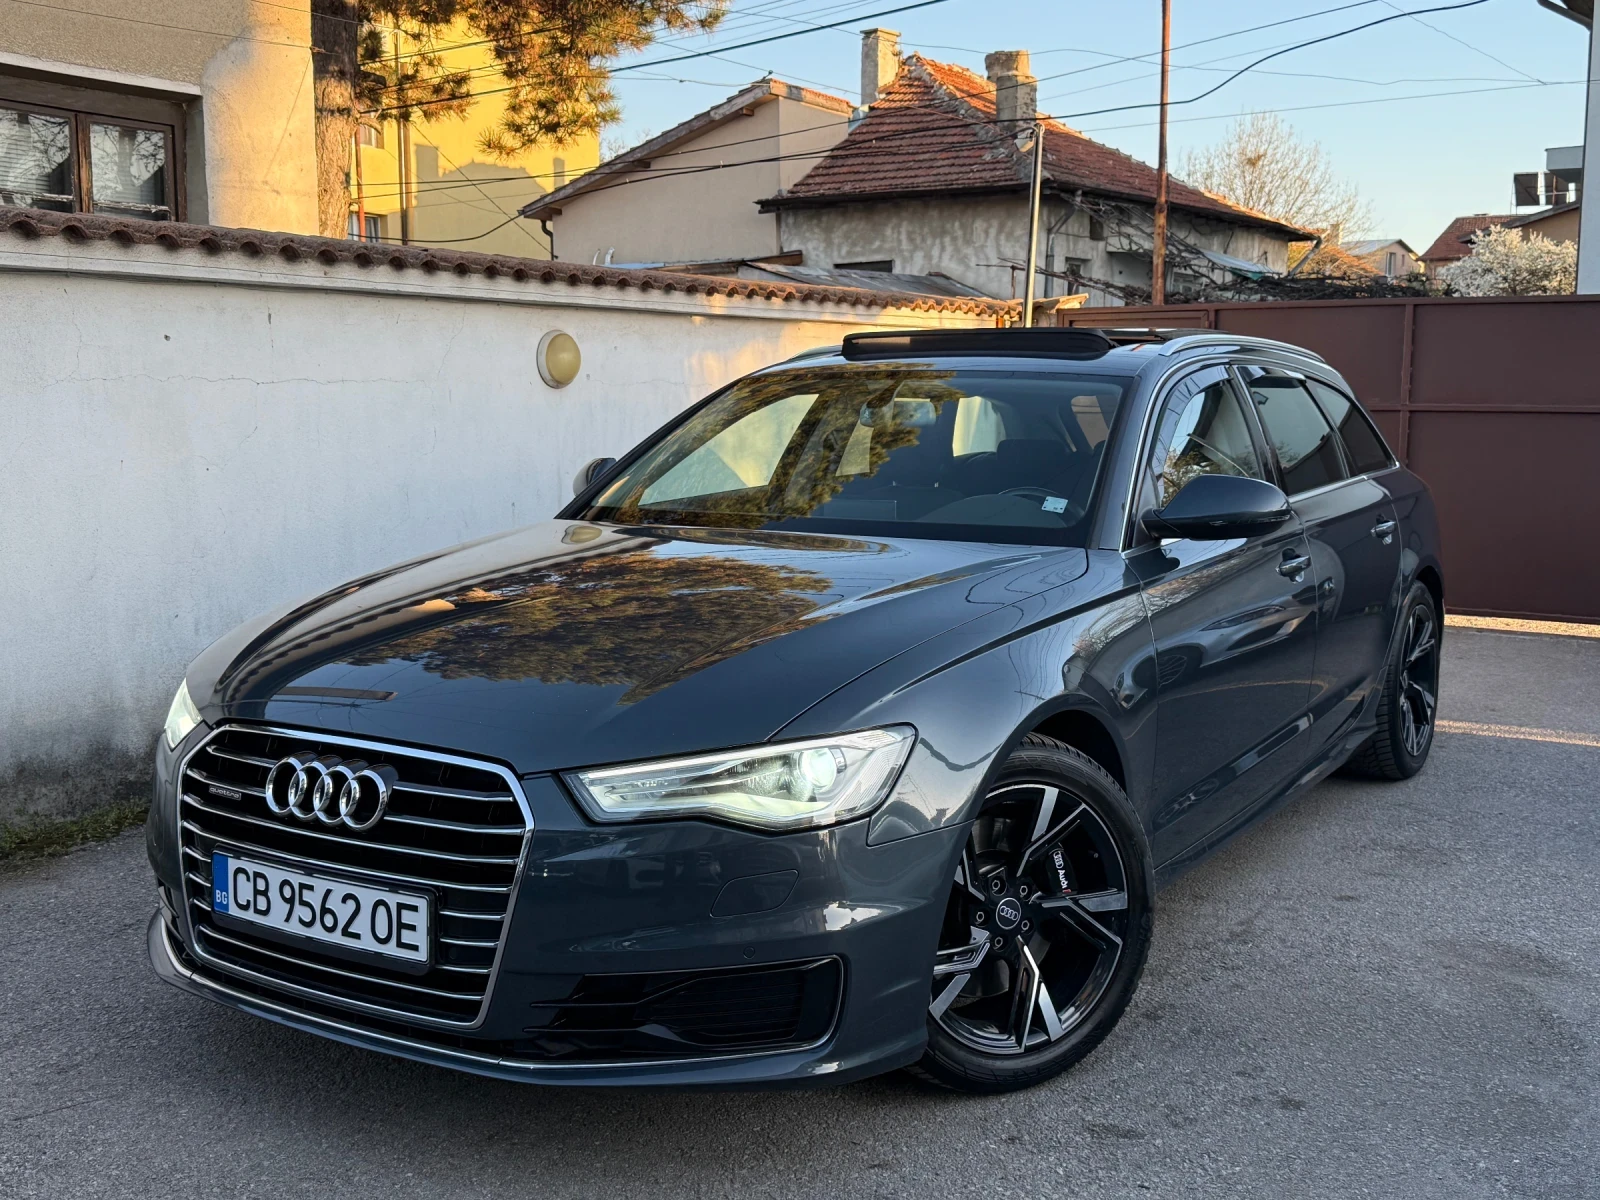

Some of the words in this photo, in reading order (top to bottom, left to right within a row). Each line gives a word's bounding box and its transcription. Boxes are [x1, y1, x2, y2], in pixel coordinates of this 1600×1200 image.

[1057, 869, 1069, 889] Audi
[215, 889, 228, 905] BG
[233, 866, 271, 917] CB
[278, 878, 362, 941] 9562
